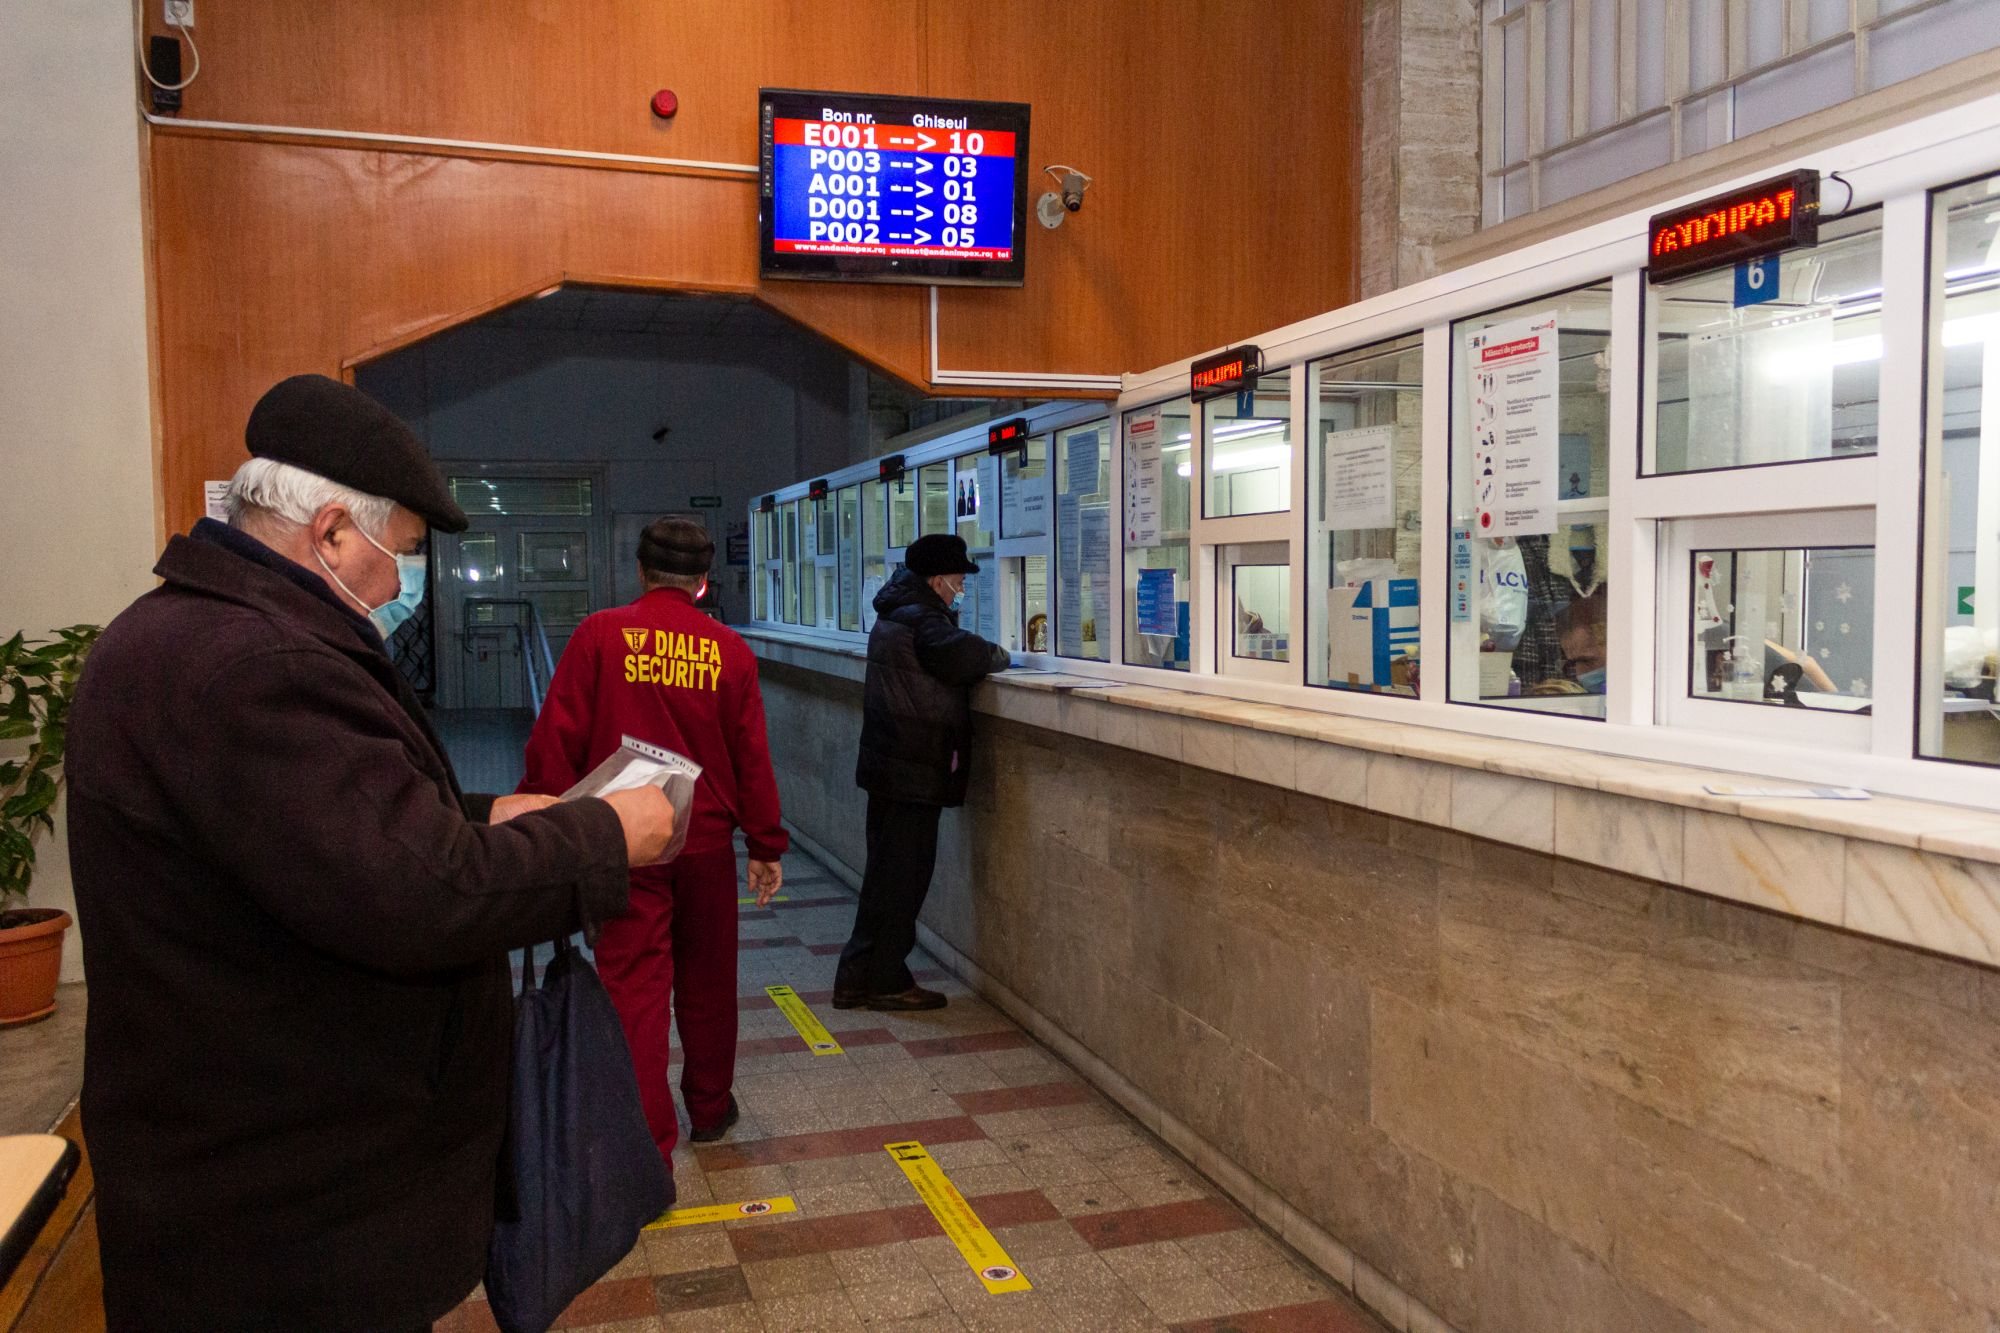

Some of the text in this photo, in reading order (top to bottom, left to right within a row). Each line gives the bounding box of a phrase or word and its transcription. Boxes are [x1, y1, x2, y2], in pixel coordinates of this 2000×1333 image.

[822, 108, 876, 124] Bon nr.
[912, 114, 967, 130] Ghiseul
[804, 123, 879, 149] E001
[949, 133, 984, 155] 10
[810, 149, 881, 173] P003
[943, 157, 978, 178] 03
[808, 174, 881, 197] A001
[943, 180, 977, 201] 01
[808, 197, 881, 221] D001
[943, 204, 978, 225] 08
[810, 222, 881, 245] P002
[941, 228, 976, 248] 05
[1747, 261, 1765, 290] 6
[655, 629, 722, 666] DIALFA
[624, 654, 722, 692] SECURITY
